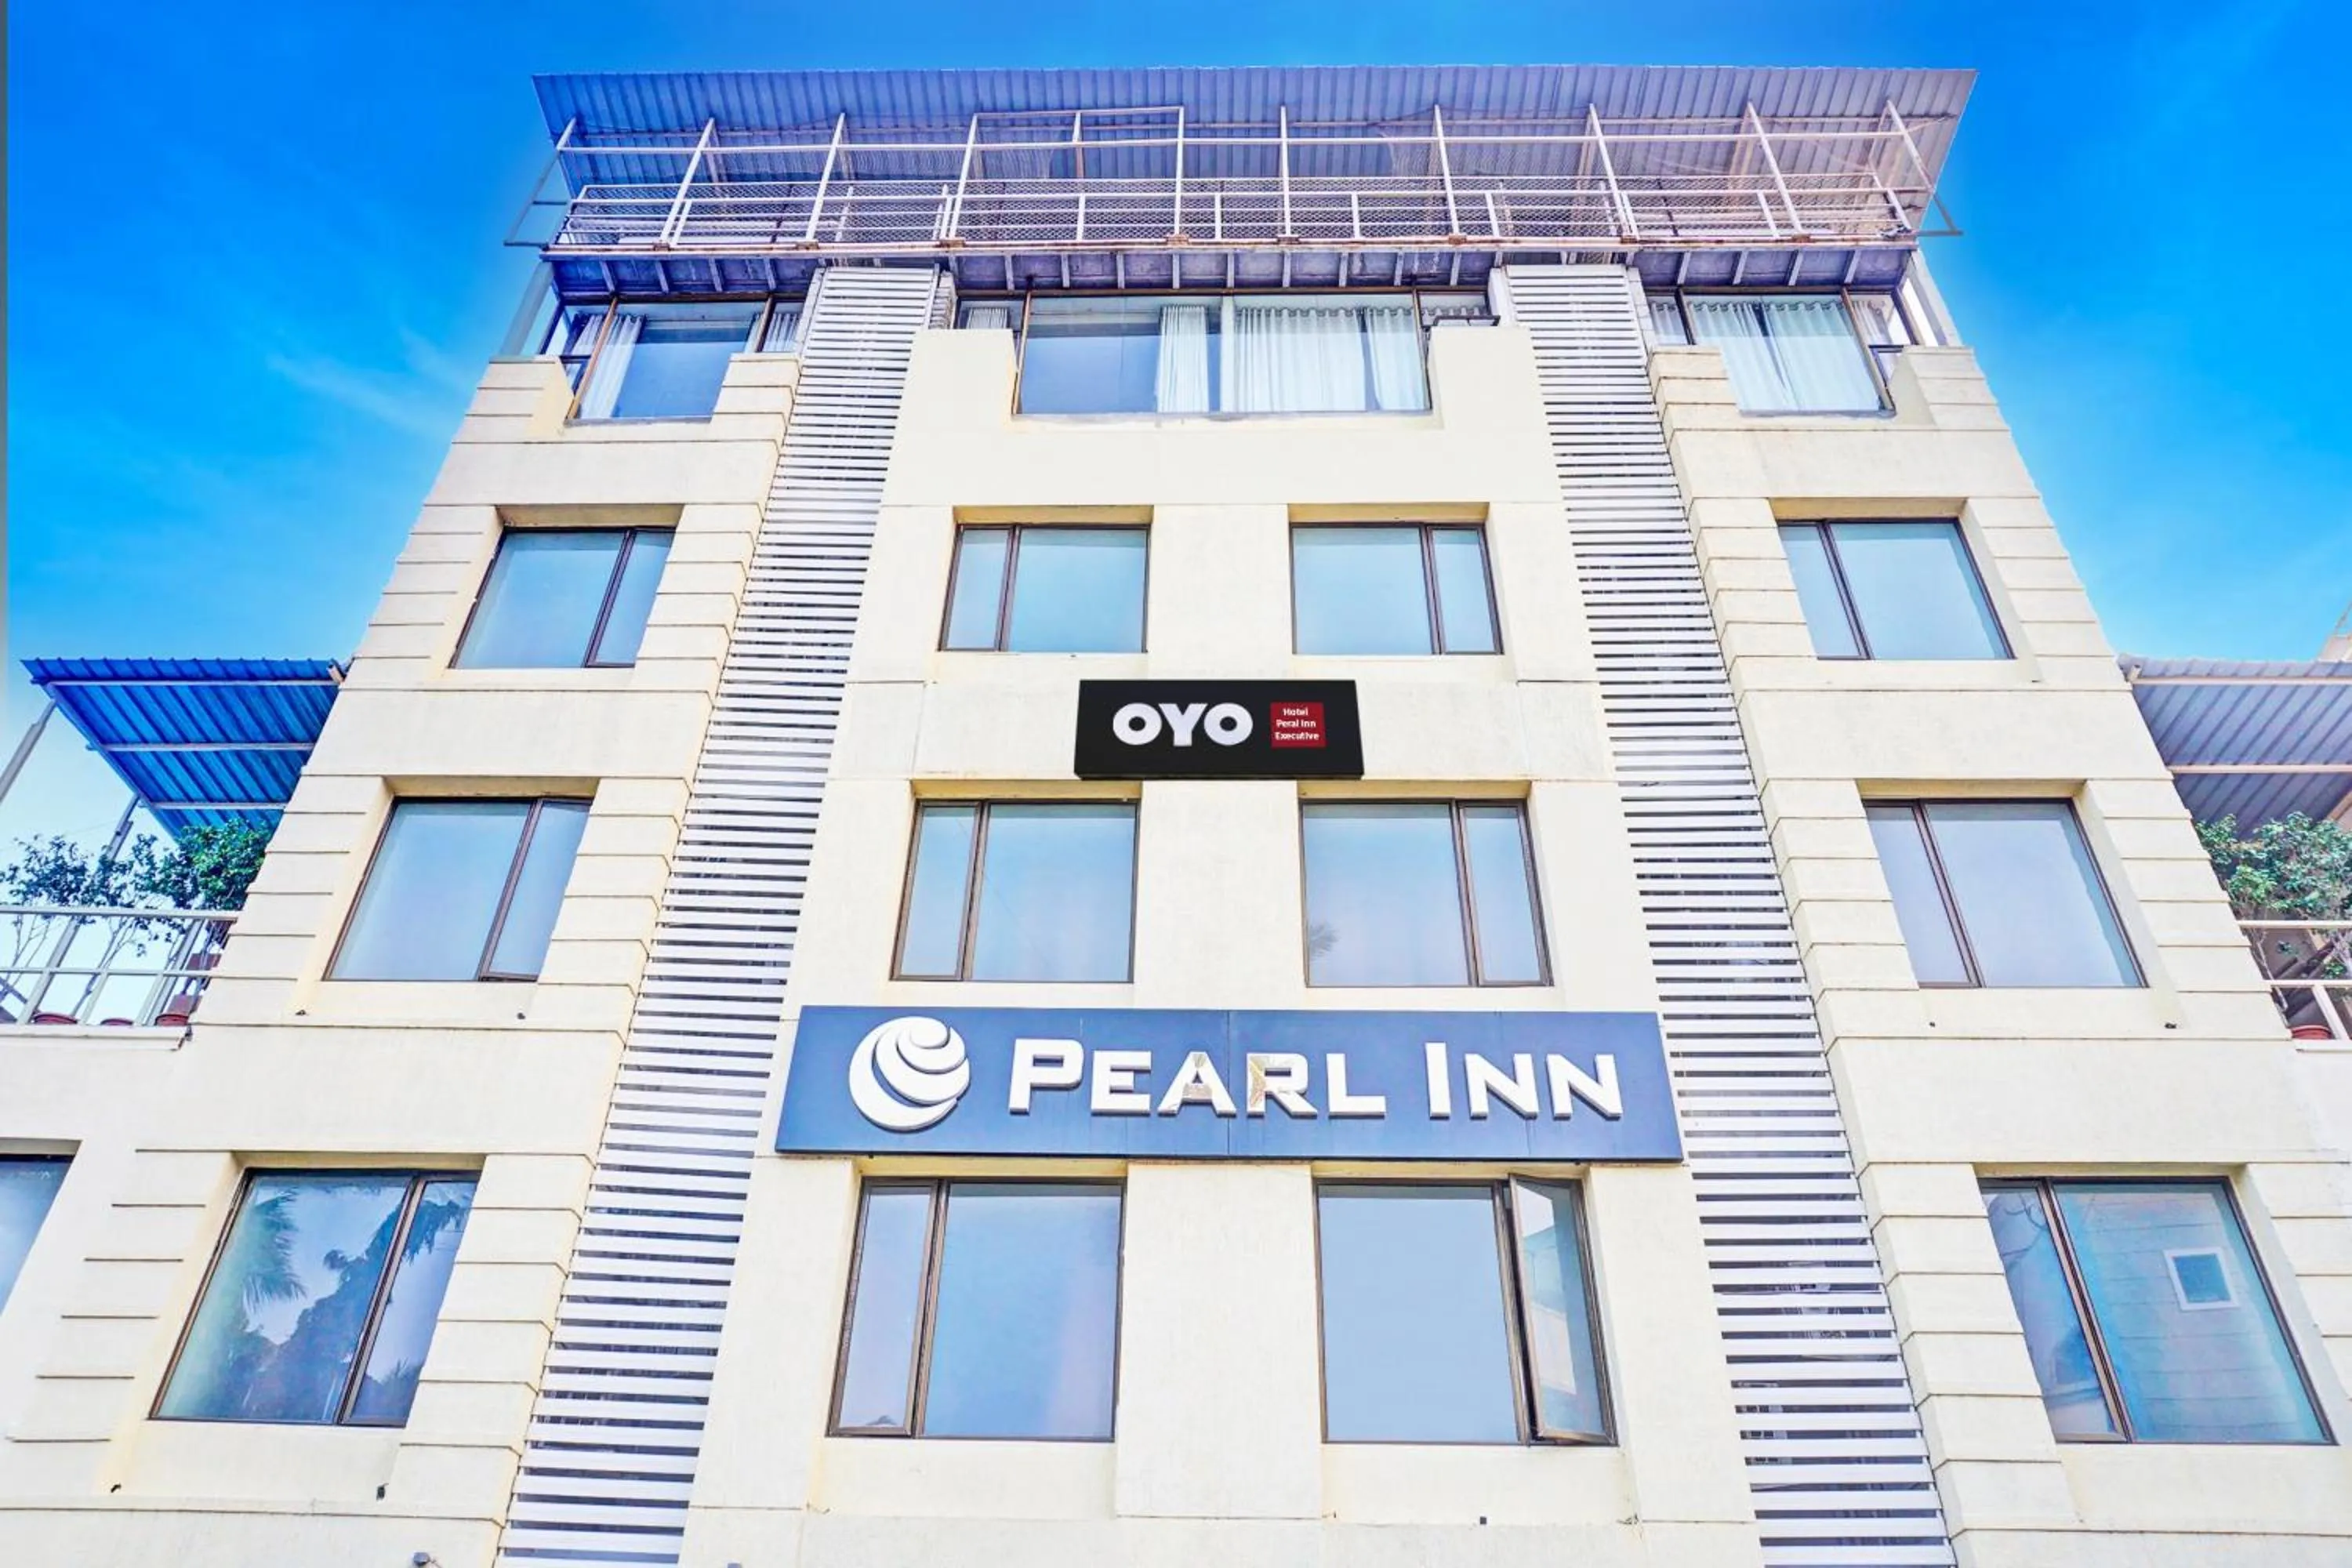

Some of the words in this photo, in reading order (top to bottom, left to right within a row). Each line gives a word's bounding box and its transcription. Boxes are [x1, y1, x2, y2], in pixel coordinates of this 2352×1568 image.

[1283, 707, 1308, 716] Hotel
[1112, 702, 1254, 746] OYO
[1276, 719, 1299, 728] Peral
[1275, 731, 1319, 740] Executive
[1008, 1039, 1387, 1117] PEARL
[1425, 1042, 1624, 1119] INN
